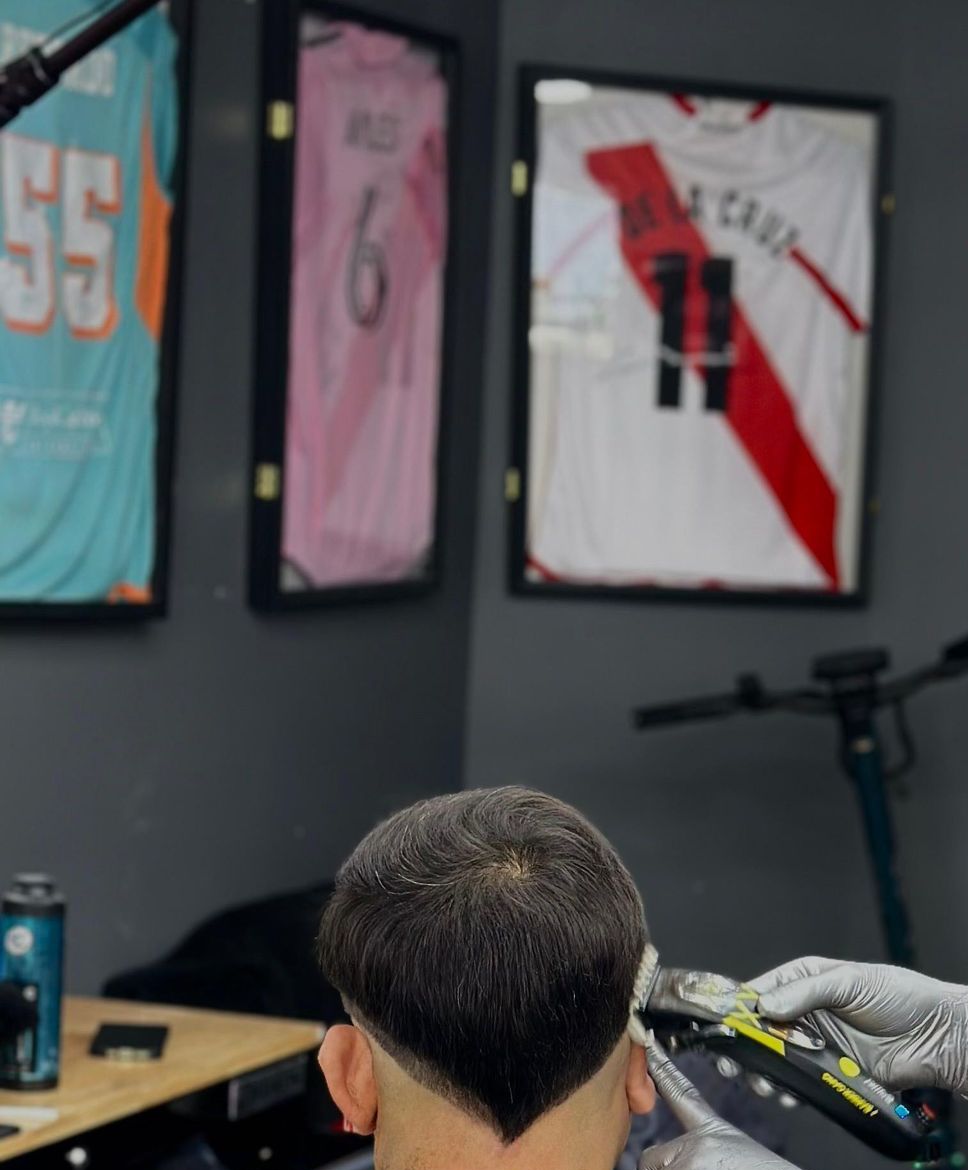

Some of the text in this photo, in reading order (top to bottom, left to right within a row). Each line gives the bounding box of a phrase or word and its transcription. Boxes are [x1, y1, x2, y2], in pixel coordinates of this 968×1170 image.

[0, 132, 121, 341] 55
[344, 184, 391, 330] 6
[651, 249, 735, 412] 11
